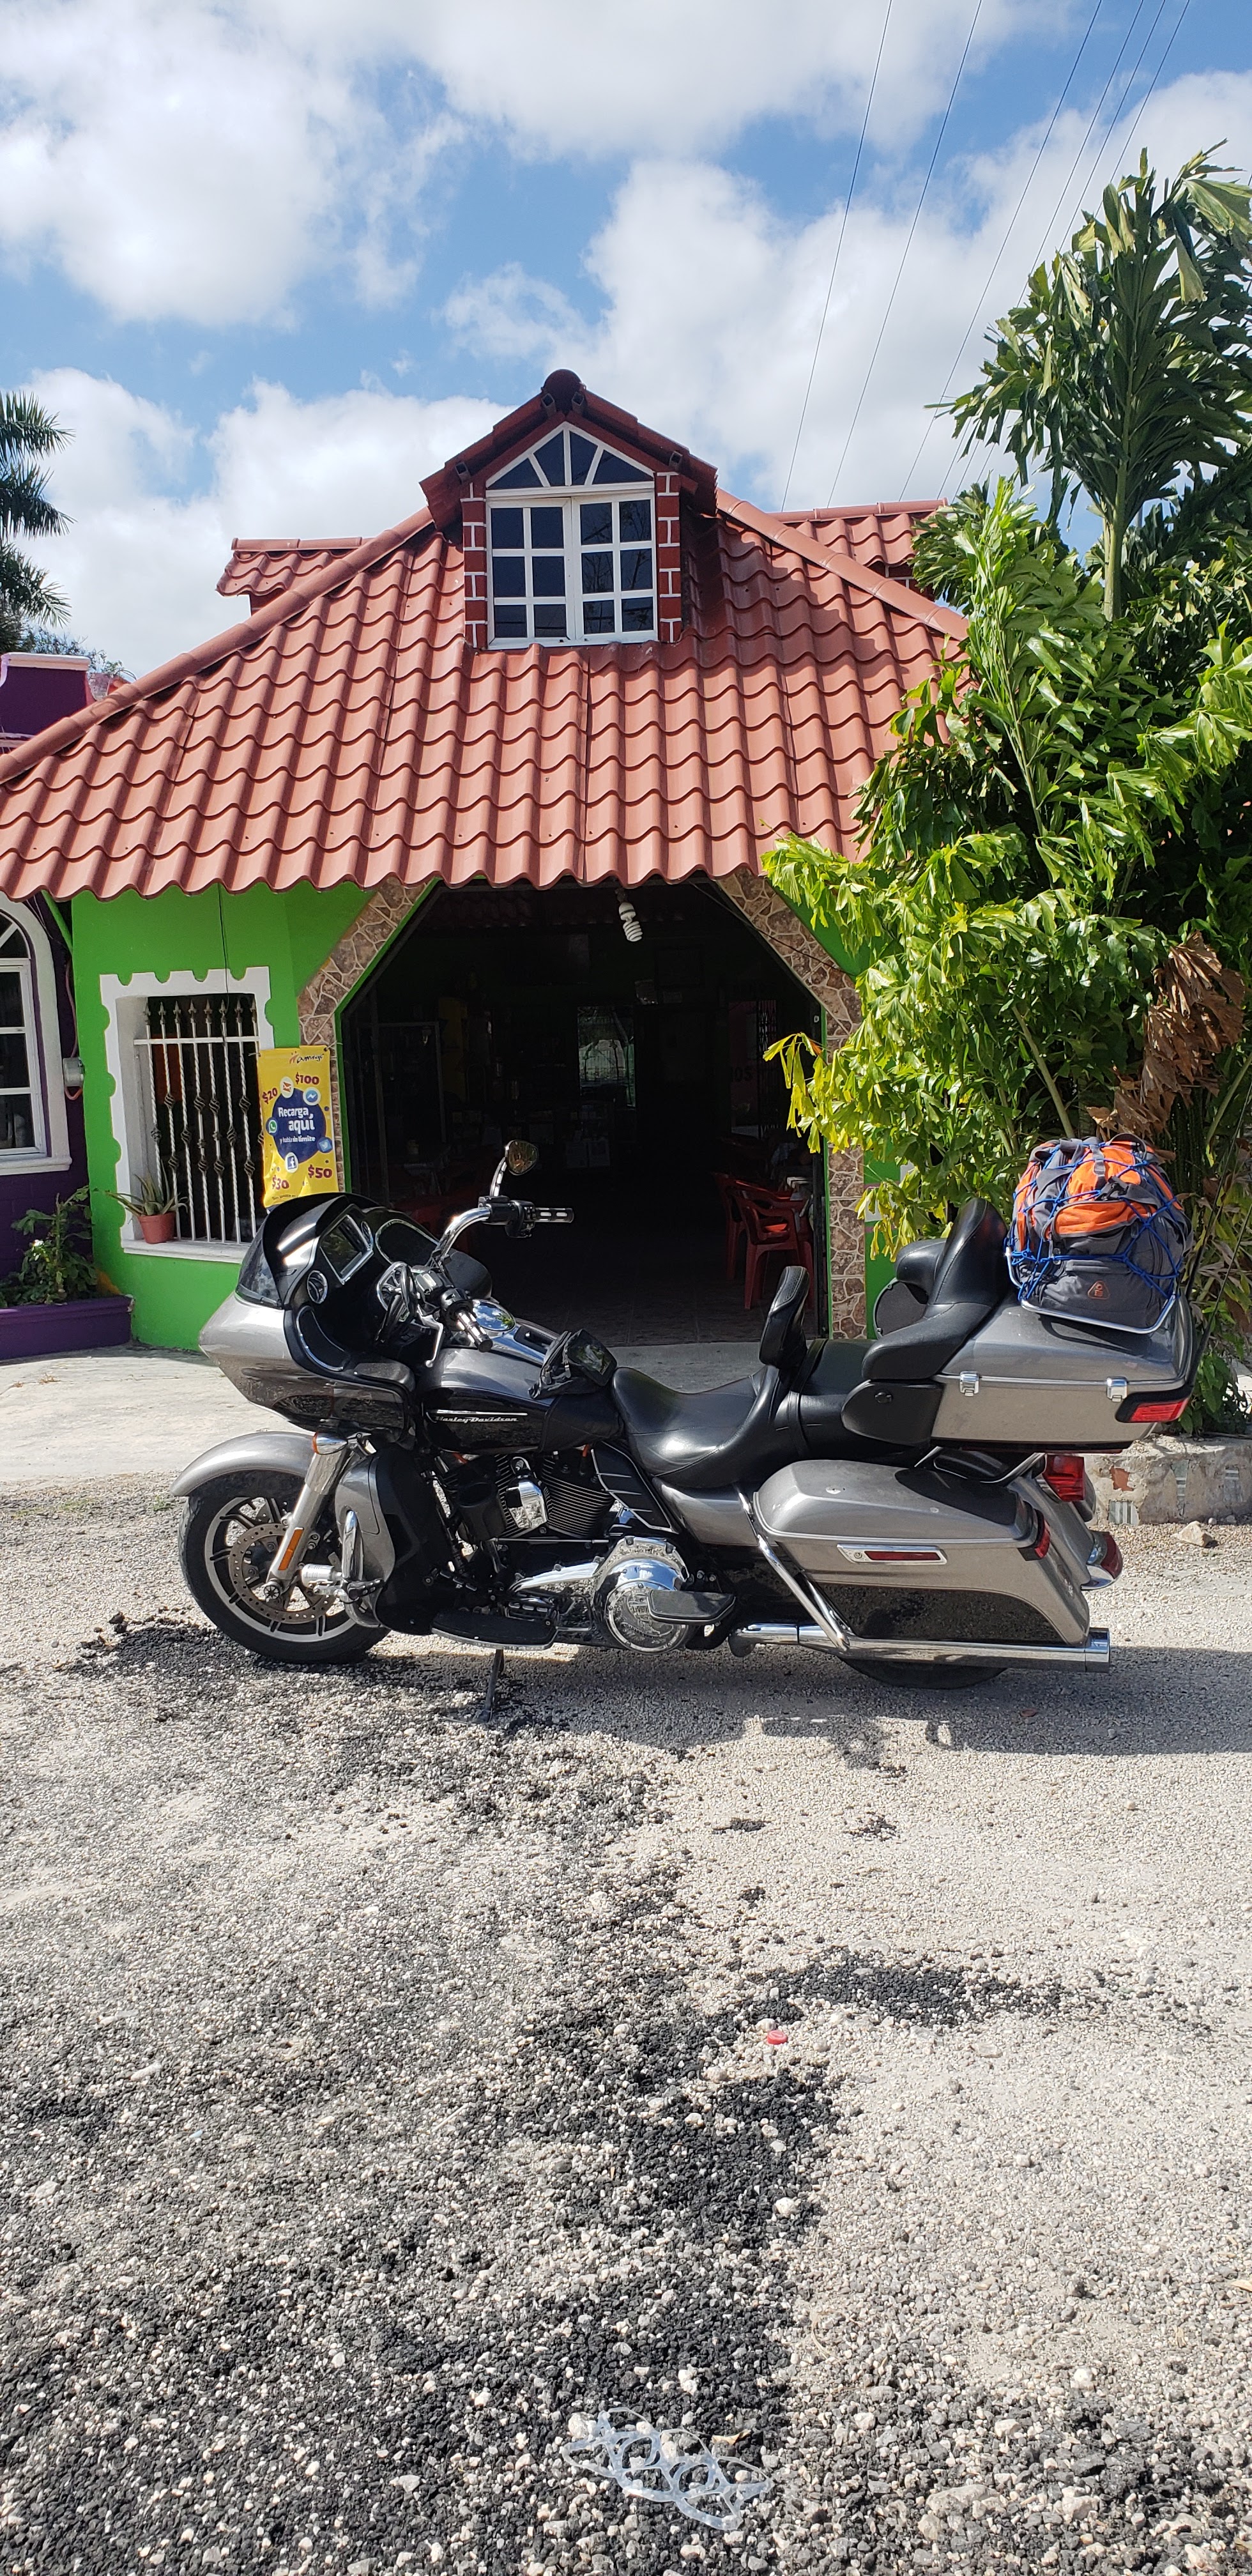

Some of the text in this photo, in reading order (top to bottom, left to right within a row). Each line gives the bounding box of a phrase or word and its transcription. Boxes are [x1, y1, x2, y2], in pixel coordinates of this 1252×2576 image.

[295, 1071, 319, 1085] $100
[262, 1087, 278, 1105] $20
[277, 1107, 309, 1119] Recarga
[288, 1113, 316, 1135] aquí
[308, 1164, 333, 1179] $50
[271, 1174, 290, 1190] $30
